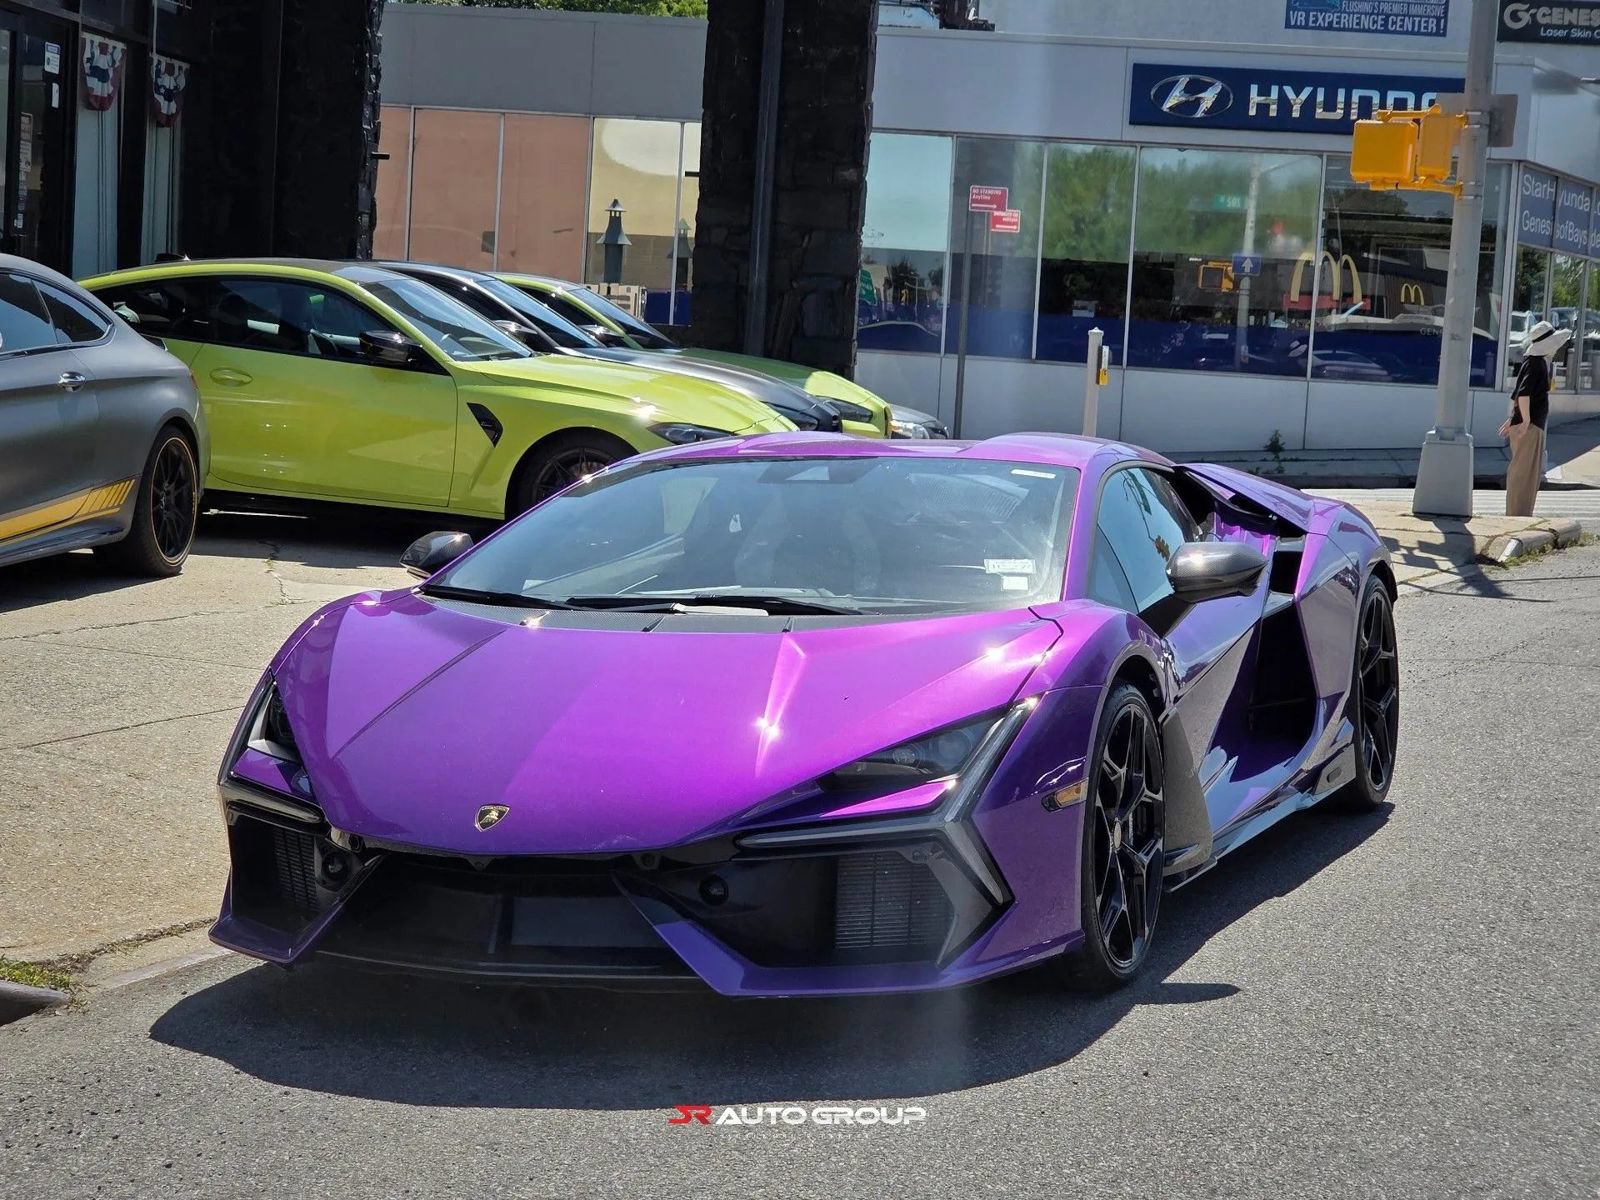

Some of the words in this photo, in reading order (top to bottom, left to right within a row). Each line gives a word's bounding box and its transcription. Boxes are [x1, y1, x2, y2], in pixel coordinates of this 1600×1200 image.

[1380, 3, 1408, 15] PREMIER
[1409, 5, 1444, 17] IMMERSIVE
[1289, 11, 1306, 26] VR
[1309, 12, 1385, 30] EXPERIENCE
[1388, 16, 1437, 33] CENTER
[1540, 26, 1569, 37] Laser
[1570, 28, 1592, 38] Skin
